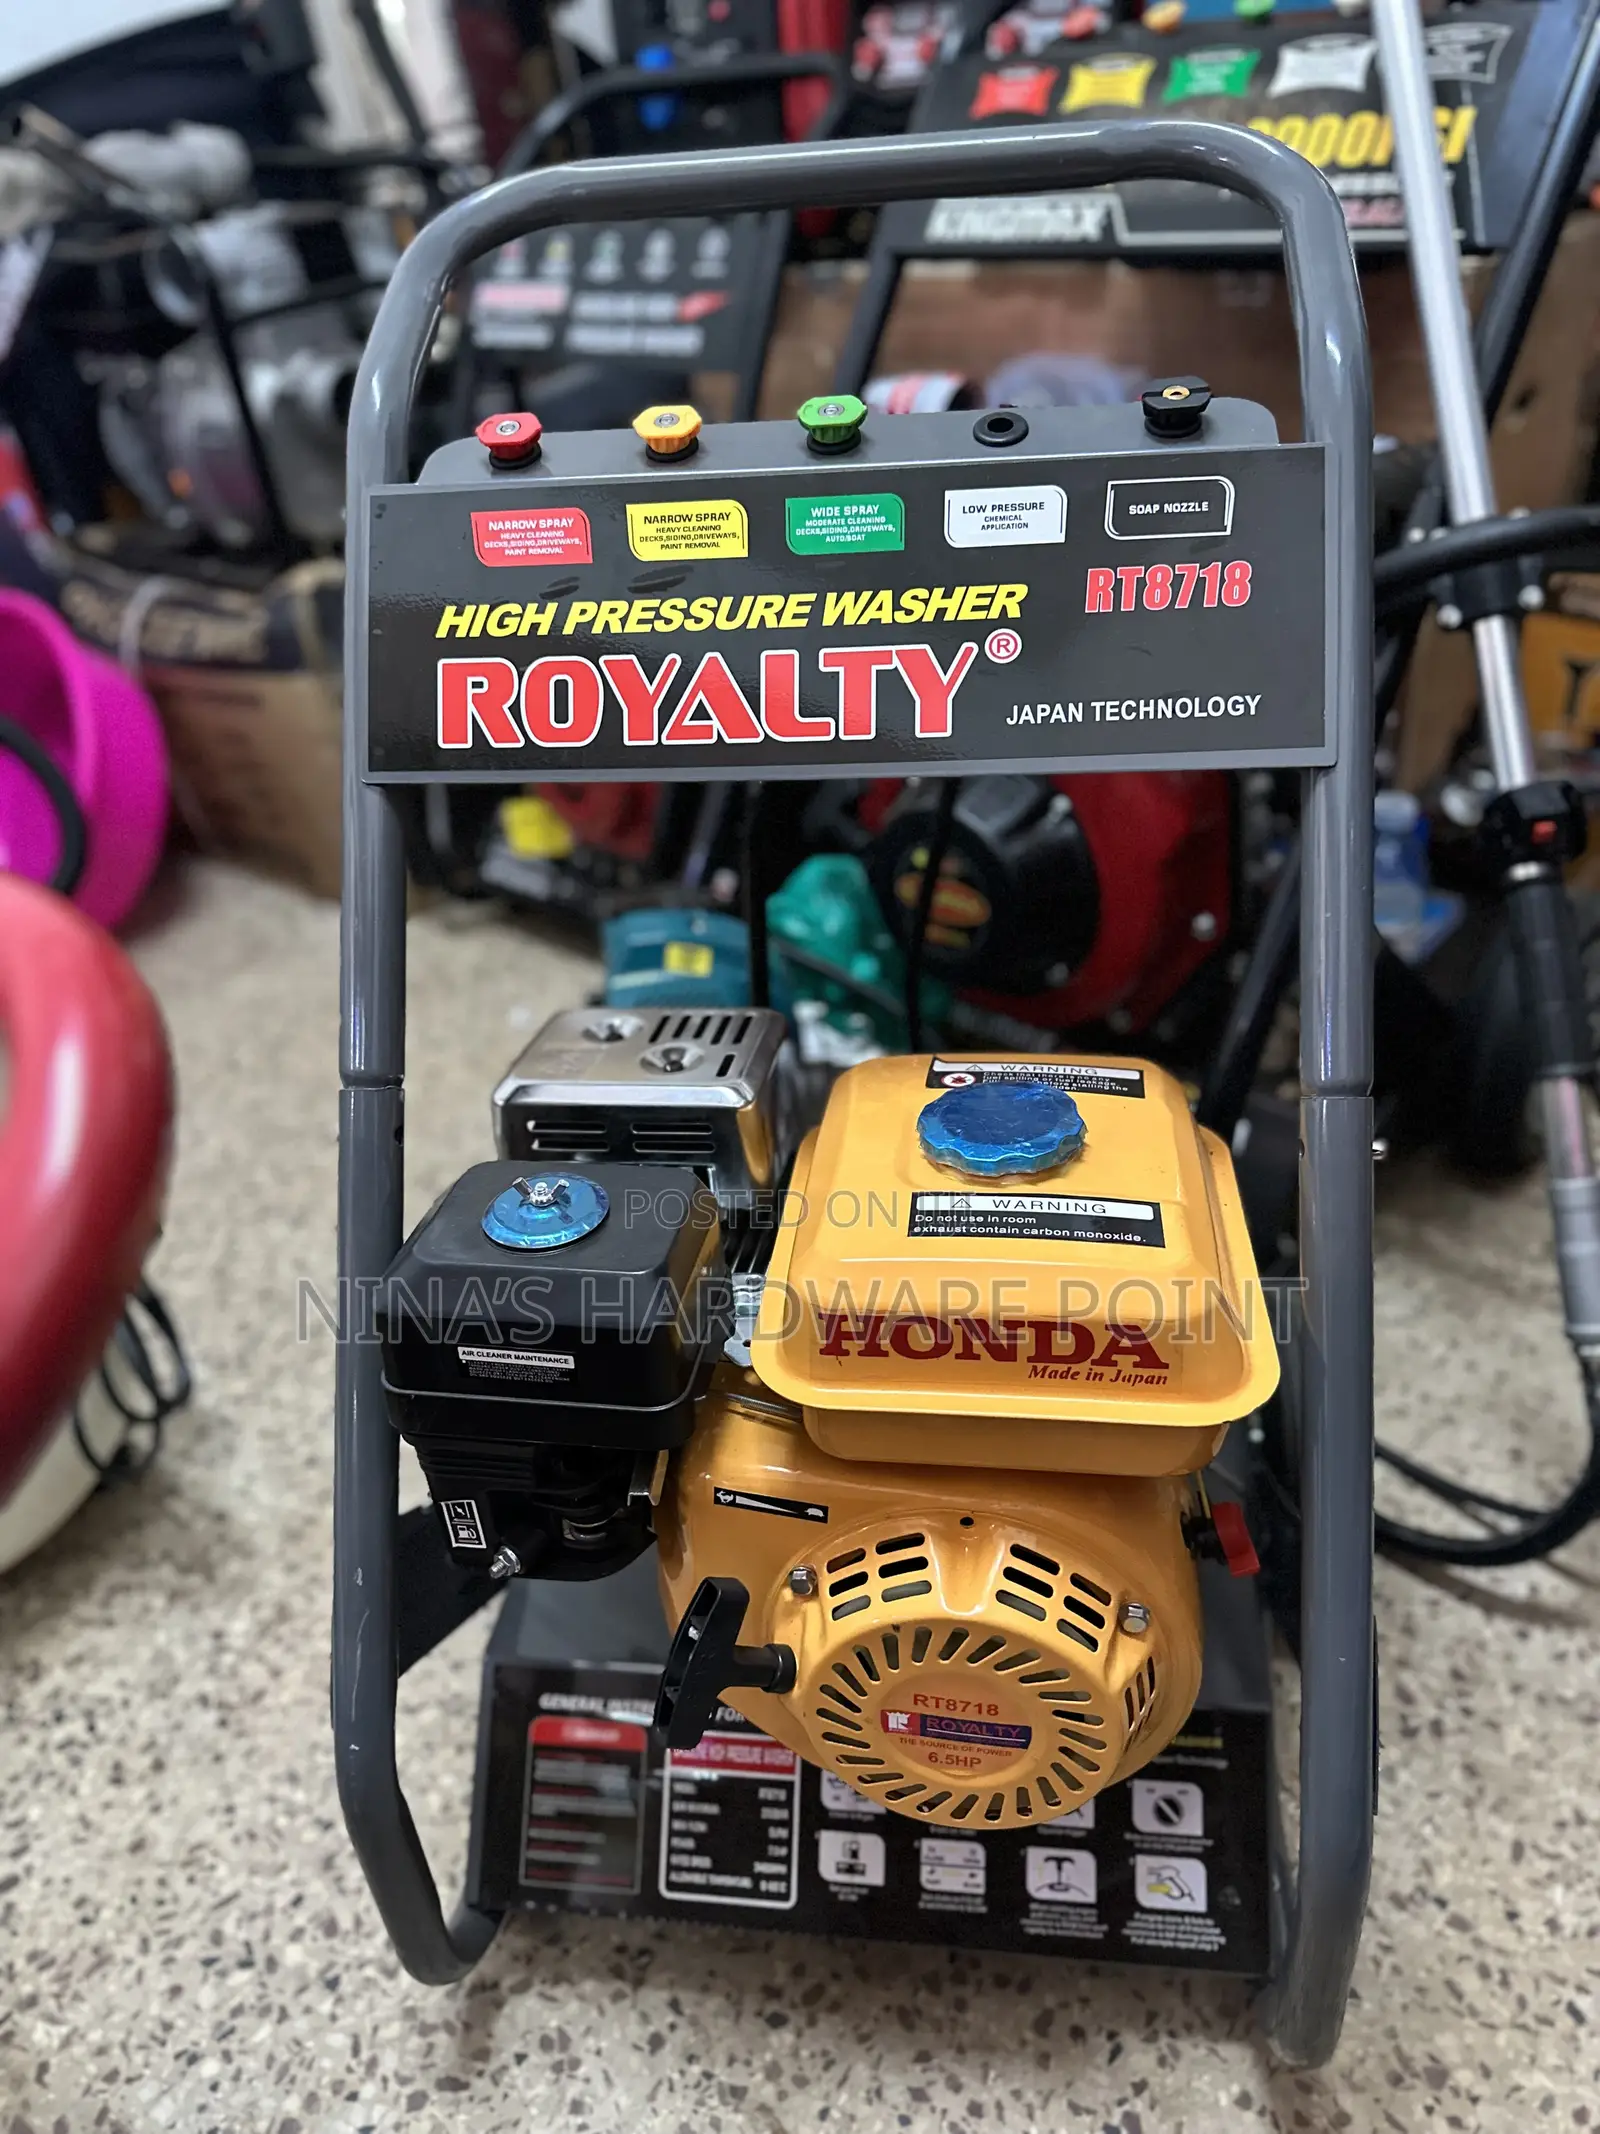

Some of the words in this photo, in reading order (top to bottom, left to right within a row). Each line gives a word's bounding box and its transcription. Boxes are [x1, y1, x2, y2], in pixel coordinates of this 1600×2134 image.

[811, 506, 841, 518] WIDE
[844, 504, 880, 516] SPRAY
[963, 504, 988, 515] LOW
[991, 502, 1045, 513] PRESSURE
[1129, 504, 1160, 516] SOAP
[1163, 501, 1209, 514] NOZZLE
[488, 519, 537, 531] NARROW
[539, 518, 574, 529] SPRAY
[644, 514, 693, 525] NARROW
[695, 512, 731, 522] SPRAY
[805, 518, 846, 527] MODERATE
[847, 516, 887, 525] CLEANING
[984, 514, 1023, 523] CHEMICAL
[656, 526, 681, 534] HEAVY
[682, 525, 721, 533] CLEANING
[981, 522, 1029, 531] APPLICATION
[500, 531, 525, 540] HEAVY
[526, 530, 564, 539] CLEANING
[504, 548, 526, 556] PAINT
[528, 547, 564, 556] REMOVAL
[660, 543, 682, 551] PAINT
[684, 542, 721, 550] REMOVAL
[1085, 560, 1252, 613] RT8718
[435, 602, 559, 638] HIGH
[562, 593, 817, 635] PRESSURE
[822, 583, 1028, 626] WASHER
[437, 641, 979, 749] ROYALTY
[1006, 702, 1083, 725] JAPAN
[1091, 694, 1262, 722] TECHNOLOGY
[1001, 1064, 1098, 1075] WARNING
[992, 1198, 1107, 1214] WARNING
[915, 1214, 934, 1223] Do
[936, 1214, 958, 1223] not
[960, 1215, 984, 1224] use
[987, 1214, 1000, 1223] in
[1002, 1215, 1037, 1224] room
[913, 1224, 968, 1234] exhaust
[969, 1224, 1021, 1235] contain
[1023, 1226, 1071, 1237] carbon
[1074, 1230, 1147, 1243] monoxide.
[818, 1312, 1170, 1369] HONDA
[476, 1351, 513, 1360] CLEANER
[514, 1353, 570, 1365] MAINTENANCE
[1028, 1364, 1080, 1382] Made
[1086, 1366, 1104, 1382] in
[1108, 1368, 1168, 1388] Japan
[913, 1693, 999, 1717] RT8718
[925, 1717, 1022, 1739] ROYALTY
[900, 1737, 918, 1746] THE
[920, 1740, 958, 1751] SOURCE
[960, 1743, 973, 1752] OF
[976, 1746, 1013, 1757] POWER
[928, 1751, 982, 1769] 6.5HP
